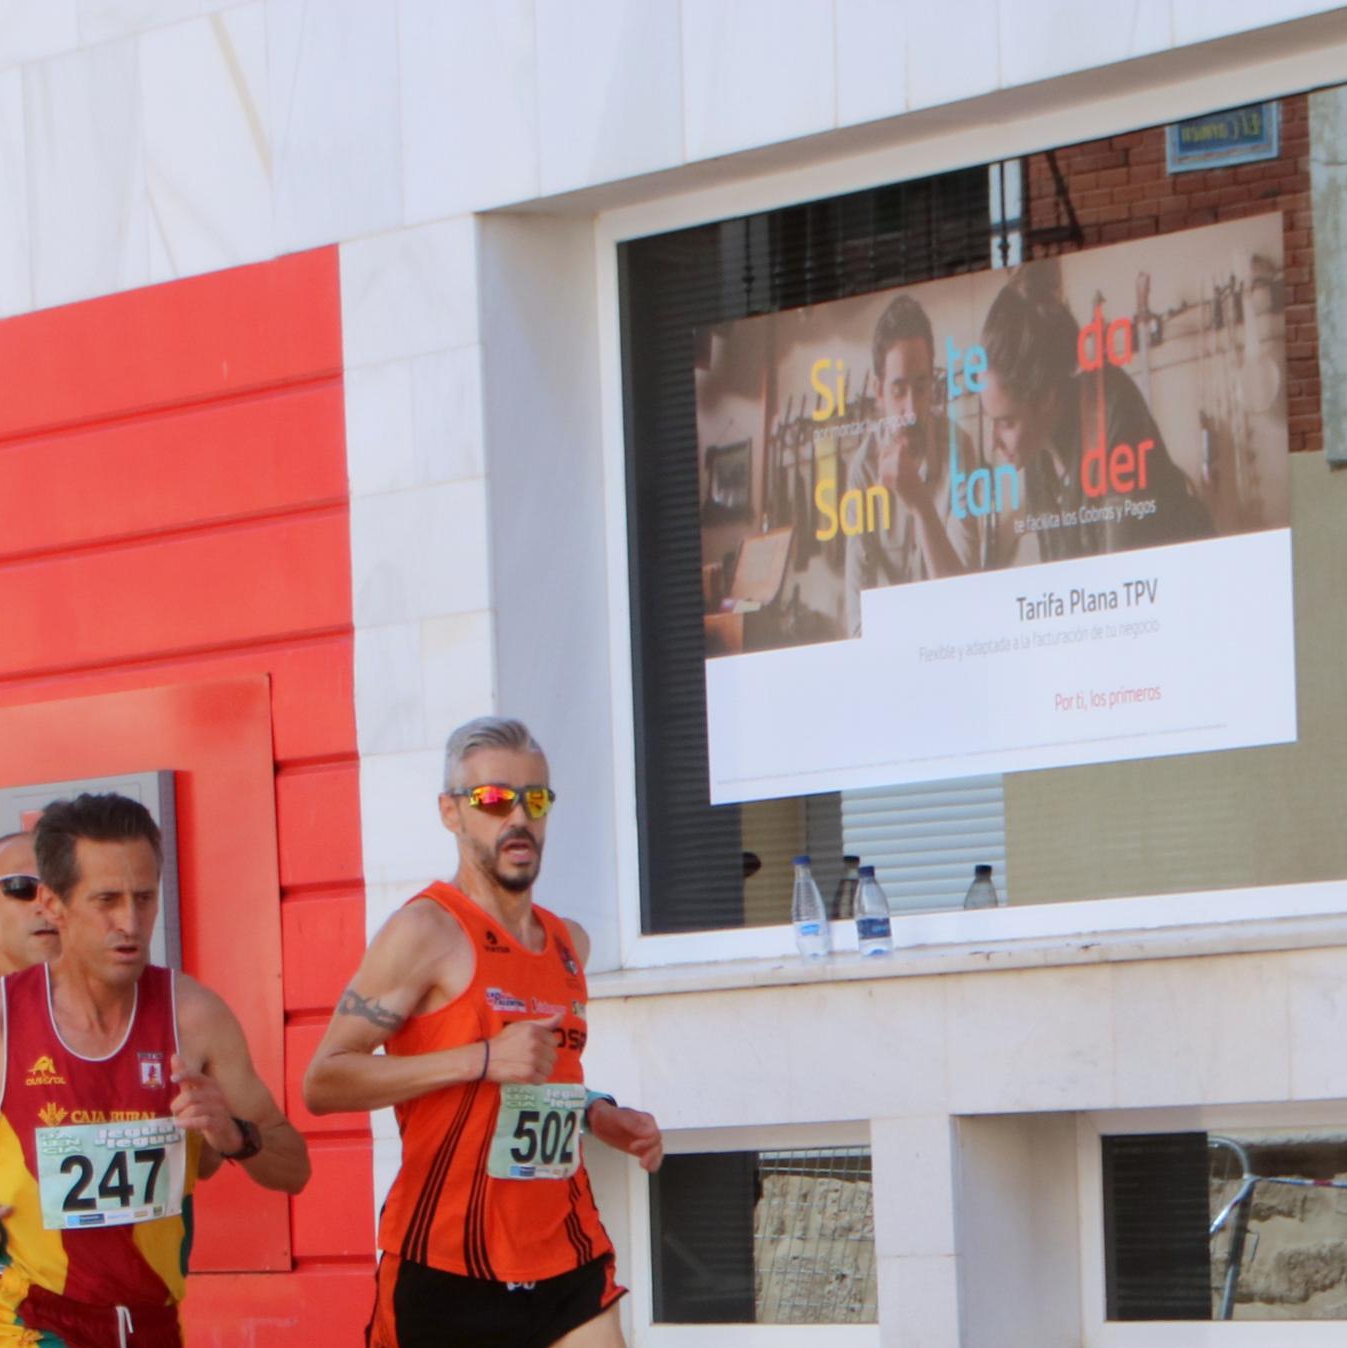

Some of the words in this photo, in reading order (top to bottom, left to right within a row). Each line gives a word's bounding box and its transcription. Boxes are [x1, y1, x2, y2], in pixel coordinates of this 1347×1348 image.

[810, 357, 846, 423] Si
[946, 335, 989, 397] te
[1076, 302, 1134, 372] da
[814, 477, 891, 542] San
[950, 460, 1021, 520] tan
[1080, 433, 1156, 498] der
[1014, 518, 1026, 533] te
[1026, 511, 1061, 533] facilita
[1061, 509, 1078, 527] los
[1078, 504, 1115, 525] Cobros
[1114, 506, 1123, 524] y
[1124, 498, 1157, 520] Pagos
[1016, 592, 1065, 622] Tarifa
[1069, 588, 1119, 615] Plana
[1122, 578, 1159, 607] TPV
[918, 643, 957, 663] Flexible
[957, 644, 965, 662] y
[964, 636, 1012, 657] adaptada
[1011, 637, 1020, 651] a
[1019, 634, 1031, 650] la
[1032, 626, 1089, 649] facturación
[1090, 623, 1104, 640] de
[1105, 622, 1118, 638] tu
[1118, 618, 1161, 641] negocio
[1054, 692, 1075, 712] Por
[1090, 689, 1108, 708] los
[1108, 684, 1162, 710] primeros
[70, 1109, 107, 1124] CAJA
[110, 1110, 158, 1123] RURAL
[510, 1110, 577, 1165] 502
[60, 1148, 167, 1213] 247
